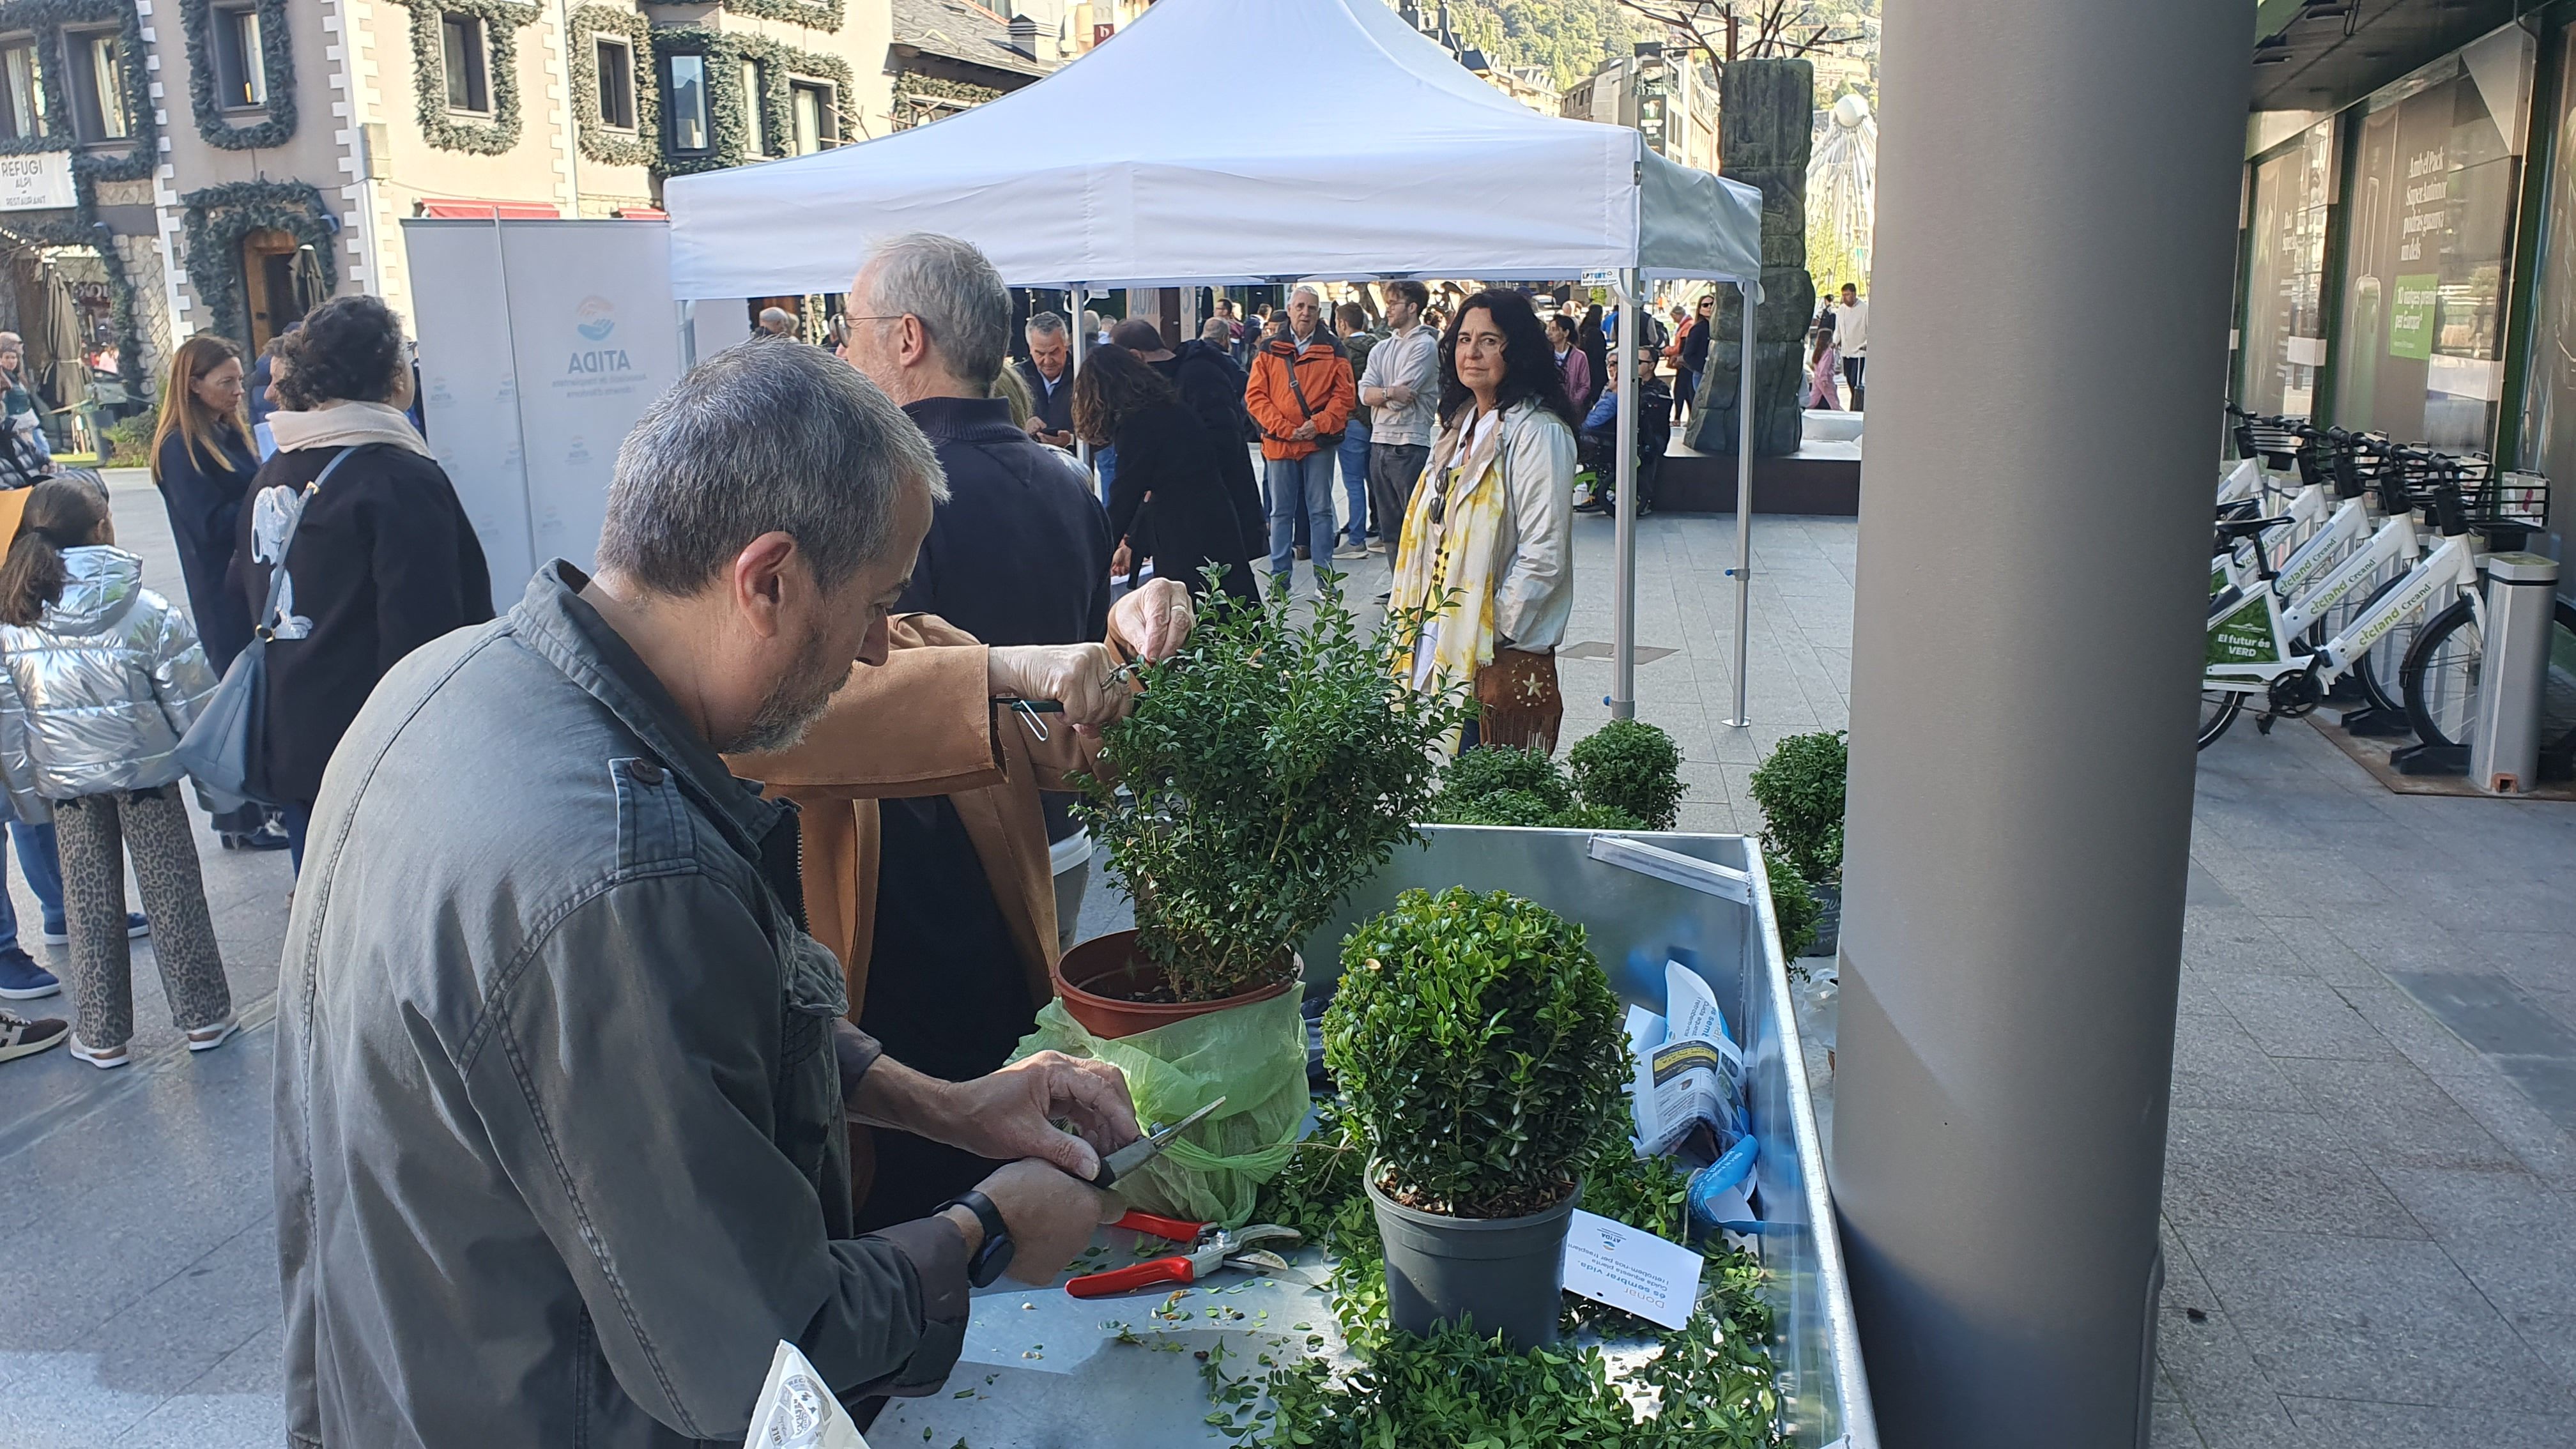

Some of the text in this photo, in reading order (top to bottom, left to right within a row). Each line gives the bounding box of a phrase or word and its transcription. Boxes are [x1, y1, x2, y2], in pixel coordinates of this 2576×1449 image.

[1, 159, 43, 177] REFUGI
[2218, 634, 2271, 648] El futur és
[2228, 645, 2257, 657] VERD
[1601, 1232, 1621, 1243] ATIDA
[1591, 1259, 1614, 1270] planta
[1600, 1255, 1614, 1264] per
[1614, 1261, 1665, 1283] retrobem-nos
[1616, 1268, 1648, 1284] aquesta
[1606, 1273, 1650, 1293] sembrar
[1623, 1288, 1665, 1308] Donar
[1654, 1289, 1666, 1300] és
